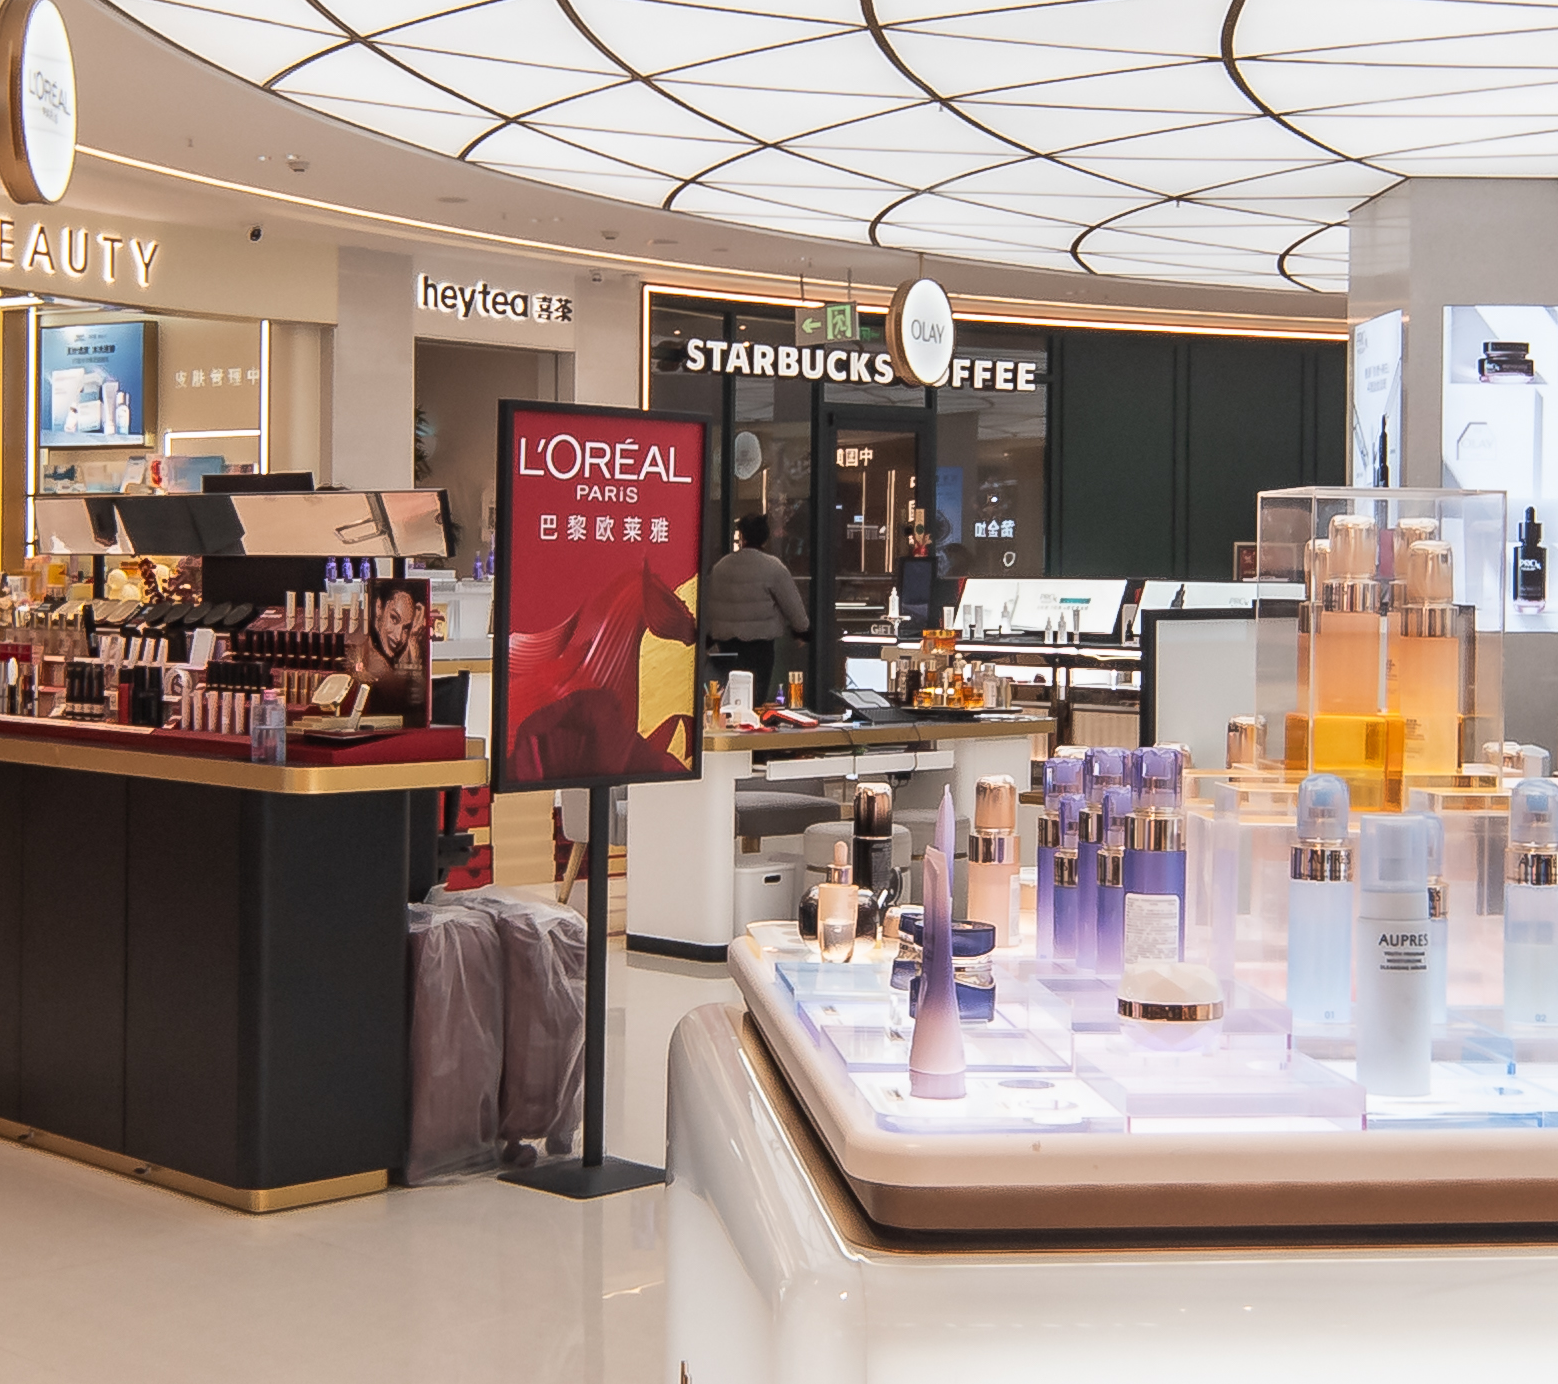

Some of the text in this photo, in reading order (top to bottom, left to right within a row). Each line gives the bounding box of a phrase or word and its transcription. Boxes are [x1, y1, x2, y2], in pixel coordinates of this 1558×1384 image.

[419, 277, 574, 322] heytea 喜茶
[911, 319, 945, 344] OLAY
[686, 338, 1036, 391] STARBUCKS FFEE
[519, 433, 692, 483] L'ORÉAL
[540, 514, 669, 543] 巴黎欧莱雅
[1378, 933, 1428, 947] AUPRES
[1324, 1010, 1335, 1020] 01
